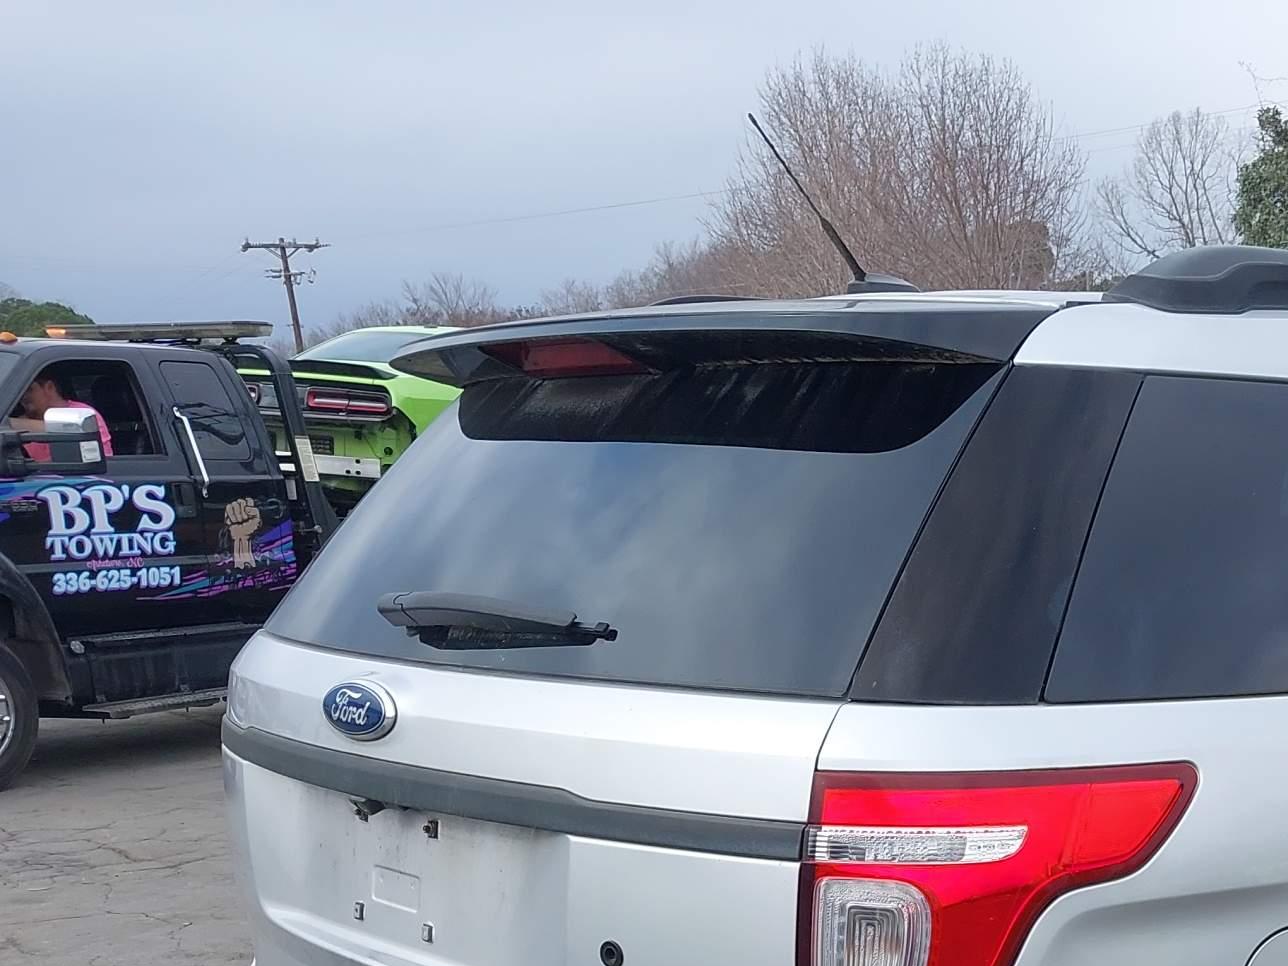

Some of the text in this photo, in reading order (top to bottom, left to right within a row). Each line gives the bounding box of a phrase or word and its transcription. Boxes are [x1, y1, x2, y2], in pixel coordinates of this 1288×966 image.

[37, 484, 175, 536] BP'S
[46, 531, 177, 561] TOWING
[52, 566, 181, 595] 336-625-1051
[331, 688, 370, 725] Ford
